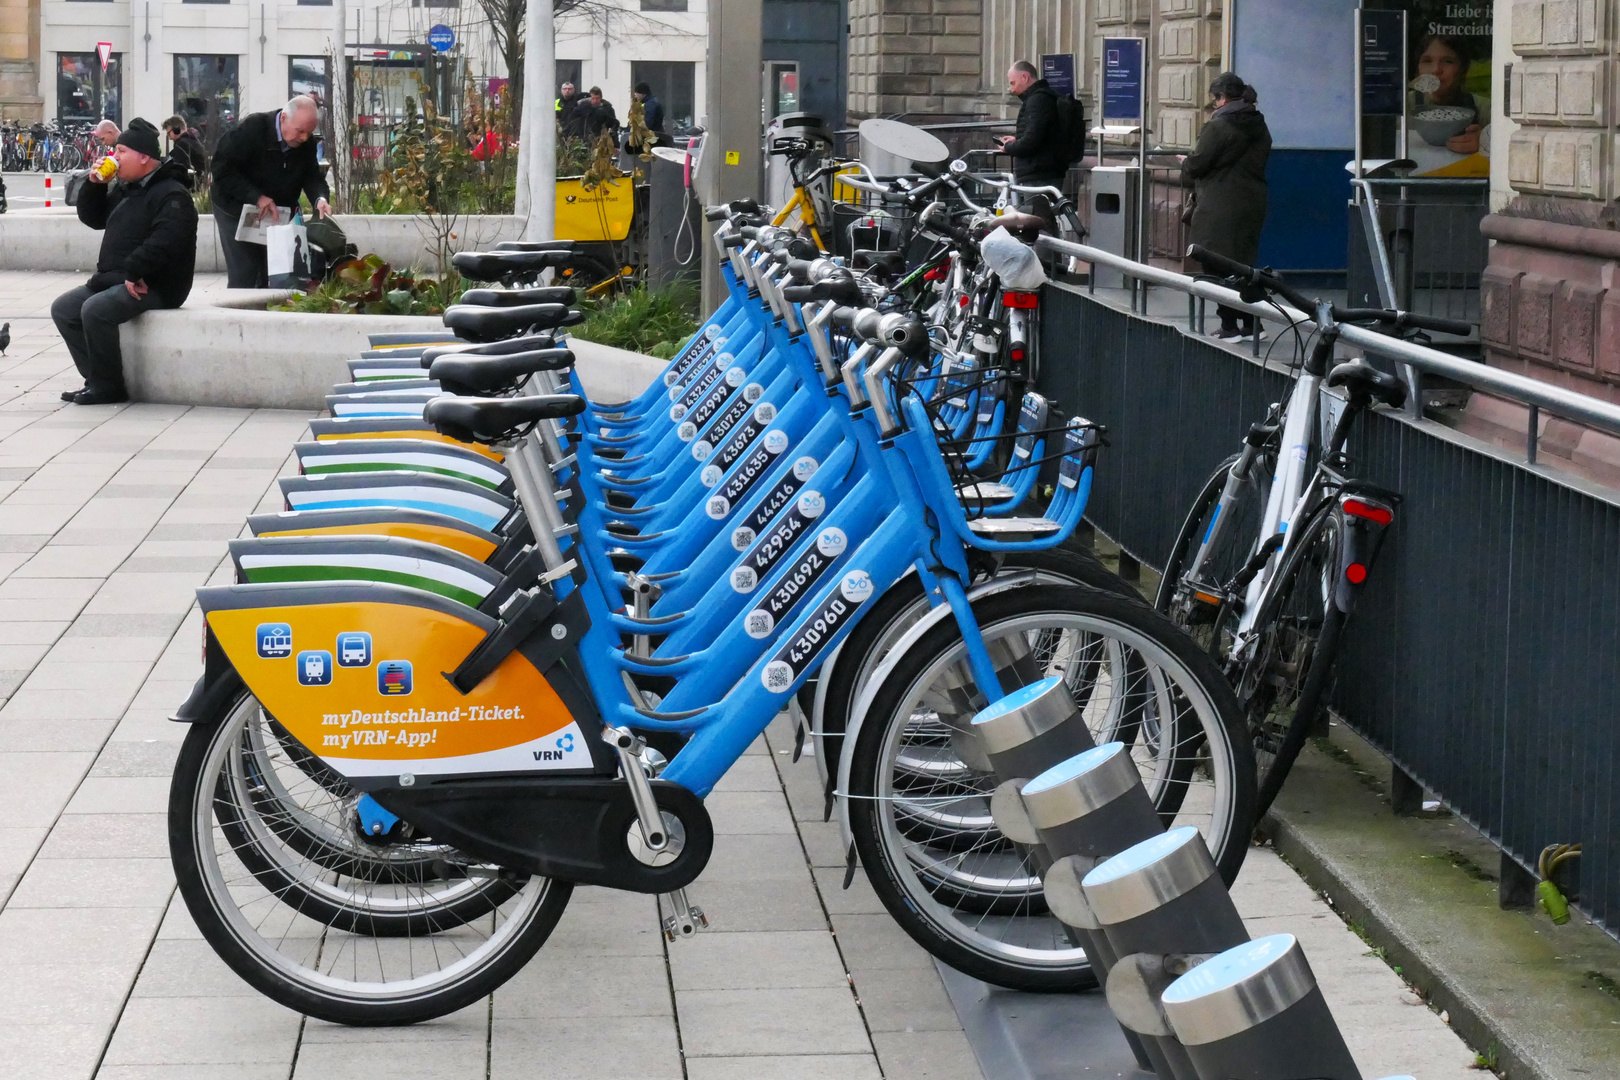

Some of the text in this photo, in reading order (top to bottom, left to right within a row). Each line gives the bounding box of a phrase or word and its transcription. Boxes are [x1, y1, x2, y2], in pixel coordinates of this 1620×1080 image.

[1445, 4, 1482, 19] Liebe
[678, 339, 709, 373] 431932
[686, 368, 720, 406] 432102
[695, 385, 727, 423] 42999
[710, 401, 747, 443] 430733
[723, 425, 756, 464] 43673
[726, 450, 769, 498] 431635
[756, 483, 794, 525] 44416
[755, 517, 802, 568] 42954
[770, 553, 823, 612] 430692
[789, 599, 847, 663] 430960
[321, 705, 525, 728] myDeutschland-Ticket.
[322, 729, 437, 749] myVRN-App!
[533, 750, 563, 761] VRN
